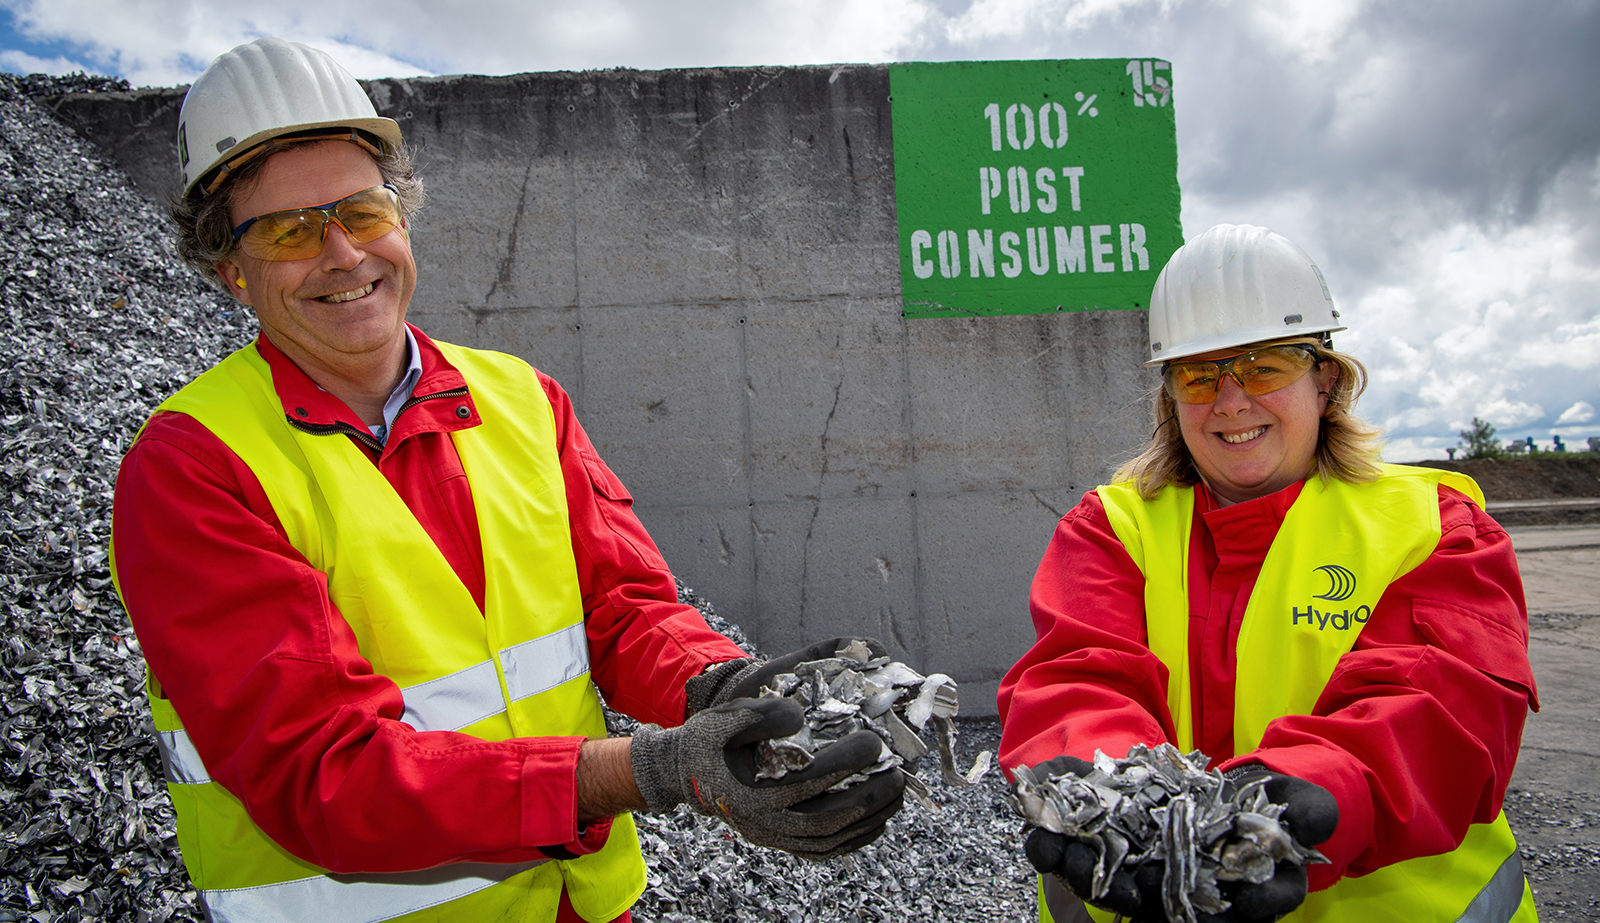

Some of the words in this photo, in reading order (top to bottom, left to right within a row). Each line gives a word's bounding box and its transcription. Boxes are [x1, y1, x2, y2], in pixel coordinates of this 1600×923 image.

[1126, 60, 1171, 107] 15
[979, 166, 1085, 215] POST
[910, 223, 1150, 279] CONSUMER
